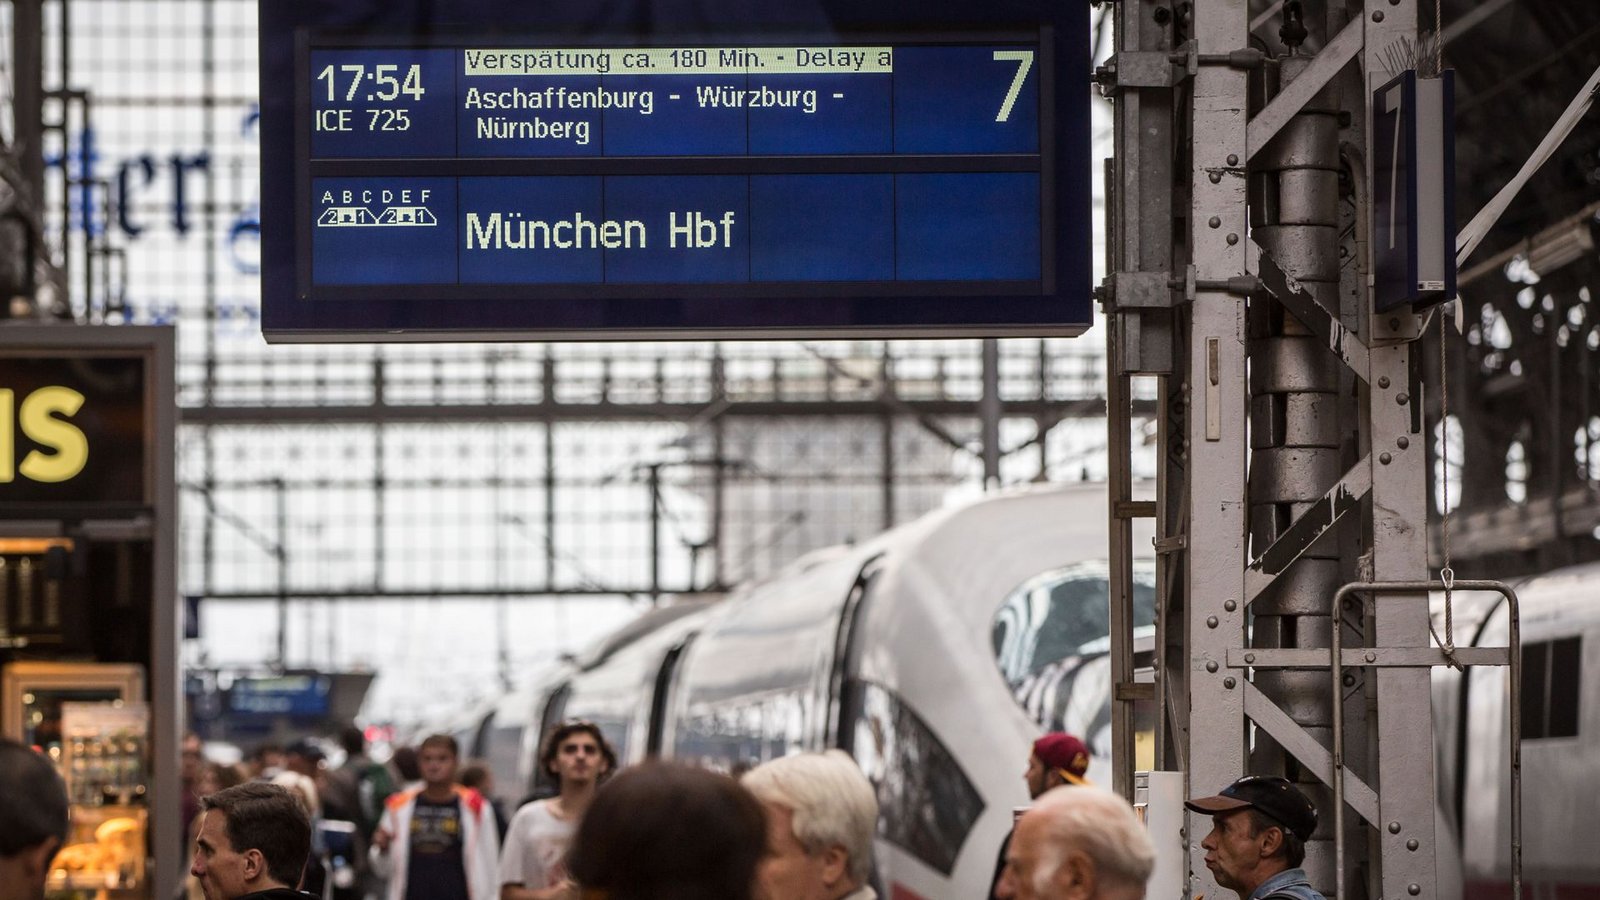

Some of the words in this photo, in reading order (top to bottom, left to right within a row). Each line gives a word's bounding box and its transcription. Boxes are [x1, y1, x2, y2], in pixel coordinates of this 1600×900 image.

[466, 50, 610, 73] Verspätung
[622, 52, 656, 68] ca.
[669, 49, 707, 68] 180
[719, 49, 765, 67] Min.
[796, 49, 866, 71] Delay
[878, 51, 891, 66] a
[317, 64, 425, 101] 17:54
[993, 50, 1035, 122] 7
[465, 87, 653, 114] Aschaffenburg
[696, 86, 817, 113] Würzburg
[316, 109, 353, 131] ICE
[366, 109, 411, 131] 725
[477, 117, 590, 144] Nürnberg
[321, 190, 334, 204] A
[342, 190, 353, 204] B
[362, 190, 372, 204] C
[382, 190, 393, 204] D
[401, 189, 412, 203] E
[421, 189, 431, 203] F
[327, 210, 337, 224] 2
[358, 210, 365, 223] 1
[386, 210, 397, 224] 2
[417, 210, 424, 223] 1
[466, 212, 646, 249] München
[669, 211, 735, 248] Hbf
